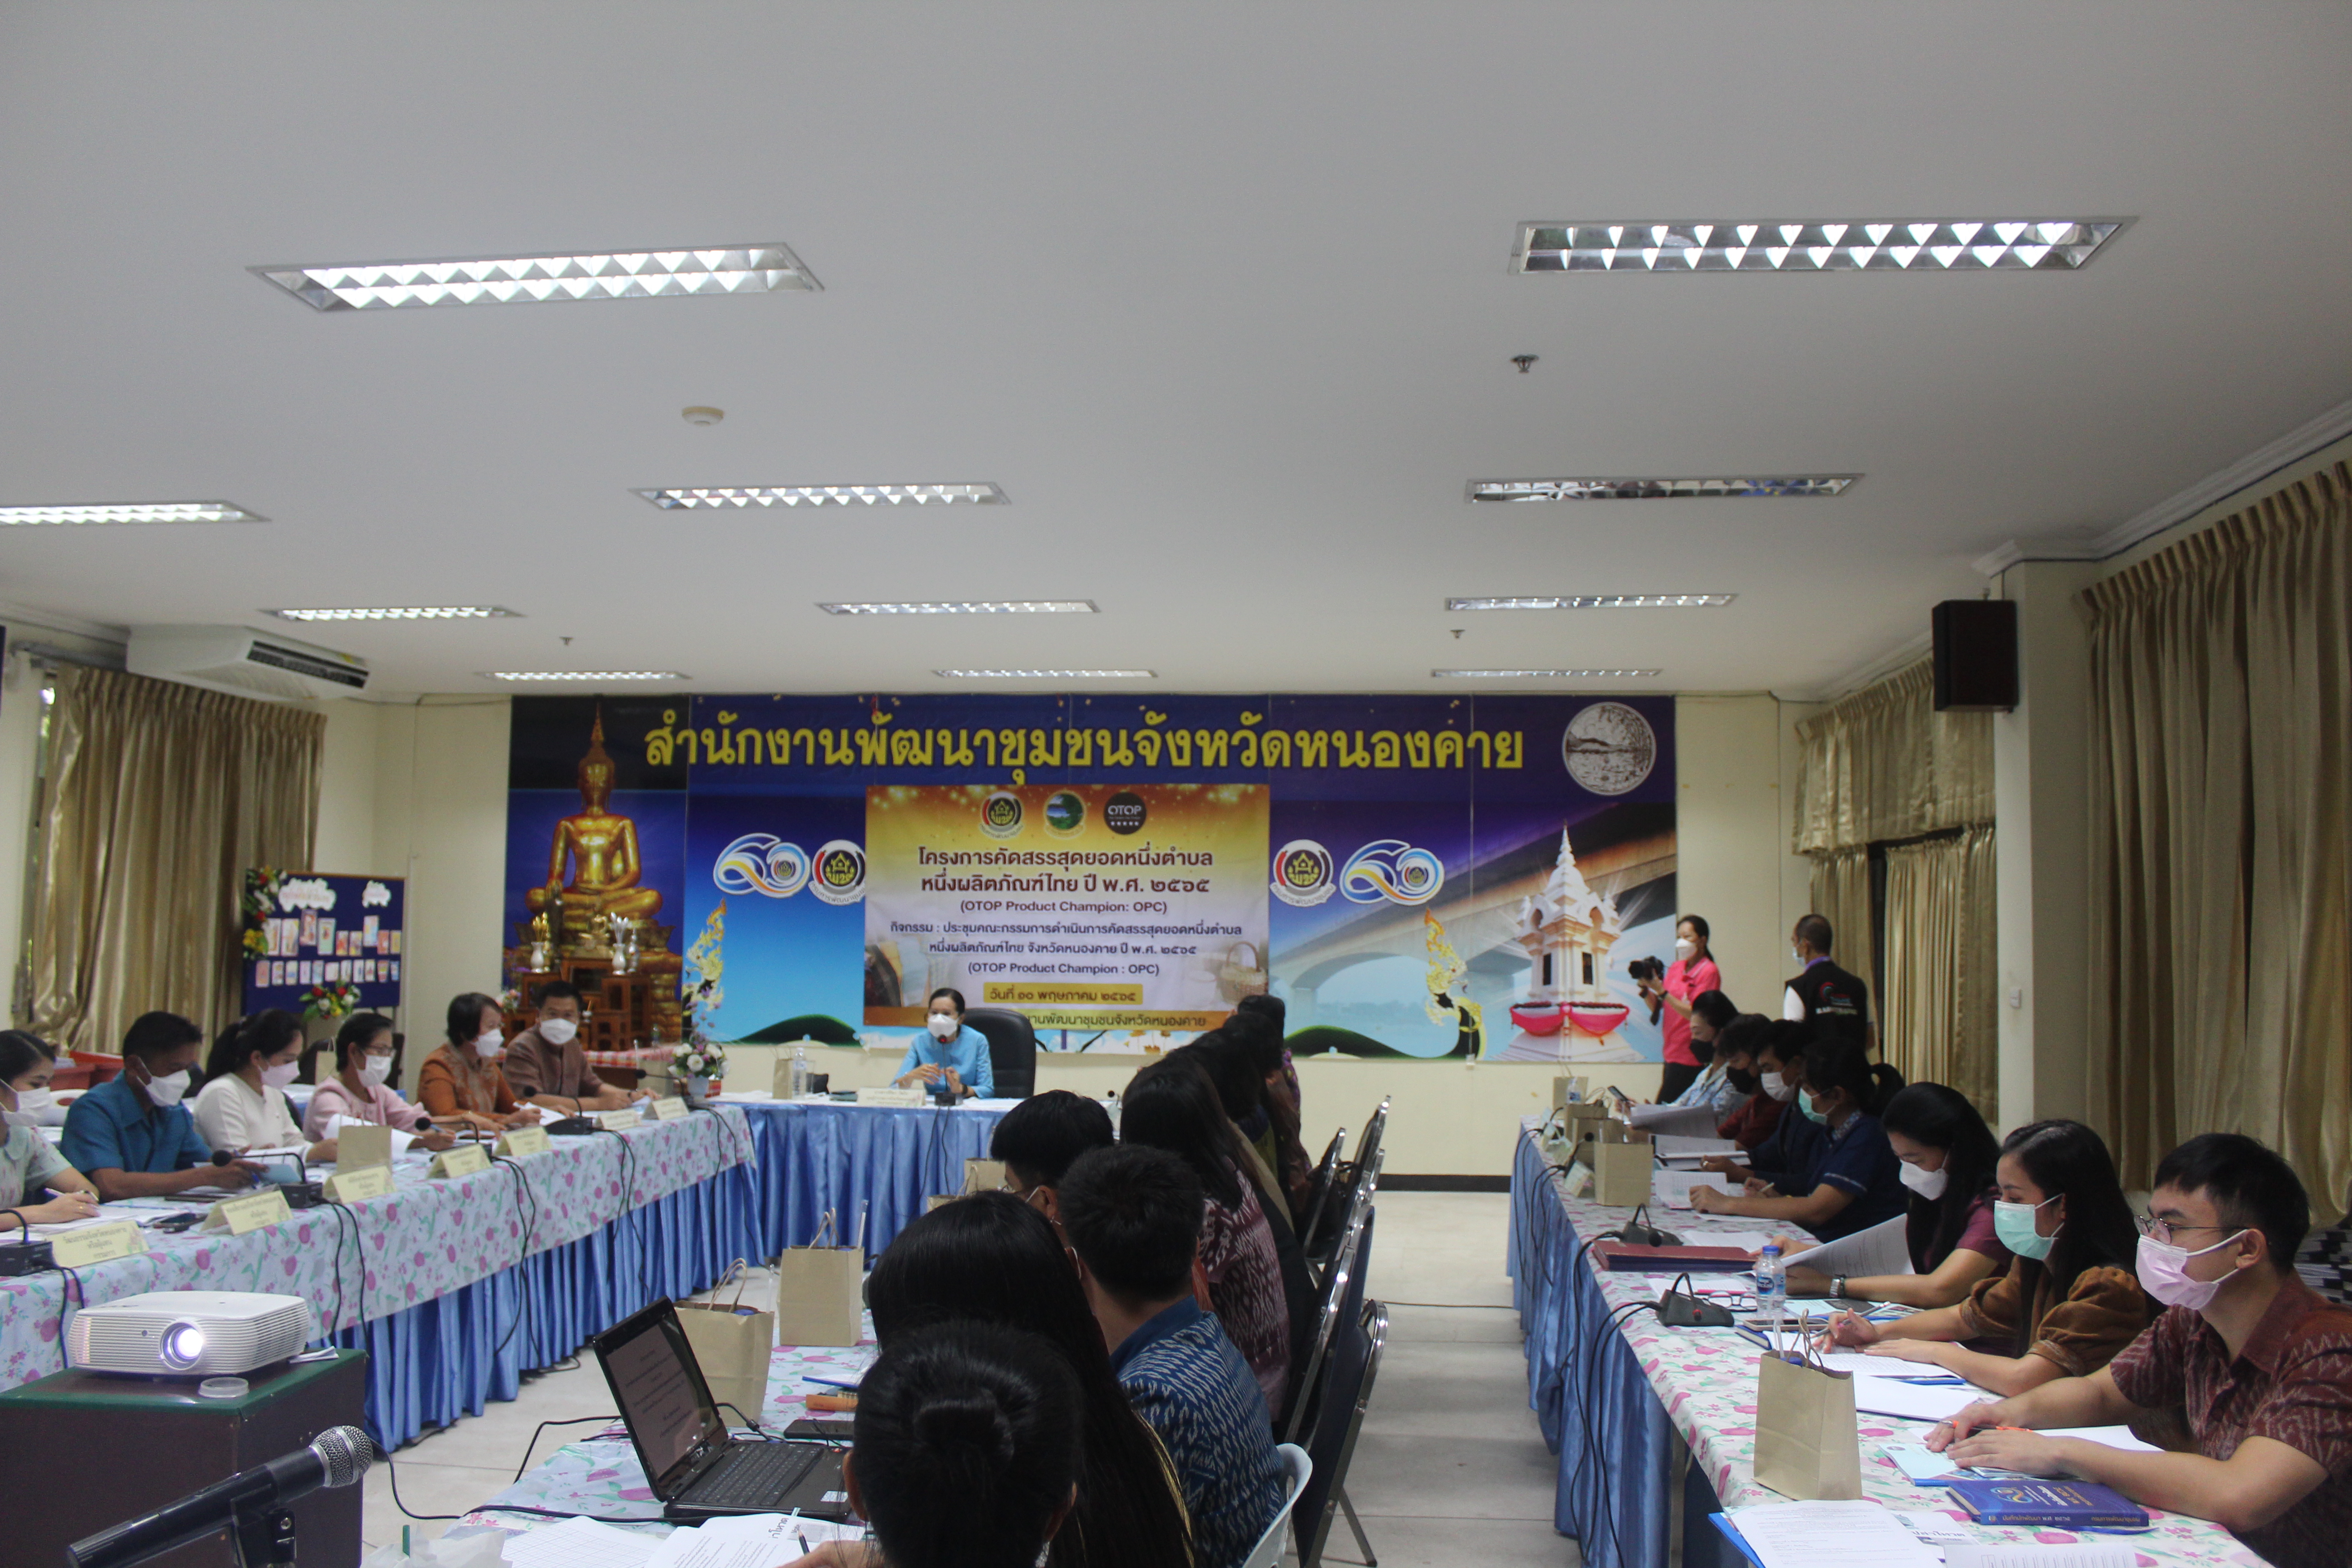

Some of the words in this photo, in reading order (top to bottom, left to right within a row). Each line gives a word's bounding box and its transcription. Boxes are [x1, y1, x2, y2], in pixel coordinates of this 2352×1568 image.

[644, 710, 1523, 785] สำนักงานพัฒนาชุมชนจังหวัดหนองคาย
[1108, 805, 1142, 815] OTOP
[918, 841, 1212, 872] โครงการคัดสรรสุดยอดหนึ่งตำบล
[921, 867, 1078, 892] หนึ่งผลิตภัณฑ์ไทย
[1083, 873, 1097, 892] ปี
[1102, 878, 1144, 892] พ.ศ.
[1151, 879, 1210, 892] ๒๕๖๕
[960, 901, 1002, 913] (OTOP
[1006, 901, 1055, 911] Product
[1059, 901, 1129, 914] Champion:
[1133, 902, 1167, 914] OPC)
[891, 921, 933, 933] กิจกรรม
[943, 919, 1242, 938] ประชุมคณะกรรมการดำเนินการคัดสรรสุดยอดหนึ่งตำบล
[929, 937, 1024, 953] หนึ่งผลิตภัณฑ์ไทย
[1028, 941, 1117, 954] จังหวัดหนองคาย
[1120, 942, 1128, 953] ปี
[1132, 945, 1157, 954] พ.ศ.
[1161, 946, 1197, 954] ๒๕๖๕
[968, 962, 1006, 974] (OTOP
[1010, 963, 1055, 973] Product
[1058, 963, 1118, 975] Champion
[1128, 964, 1159, 976] OPC)
[990, 985, 1014, 1000] วันที่
